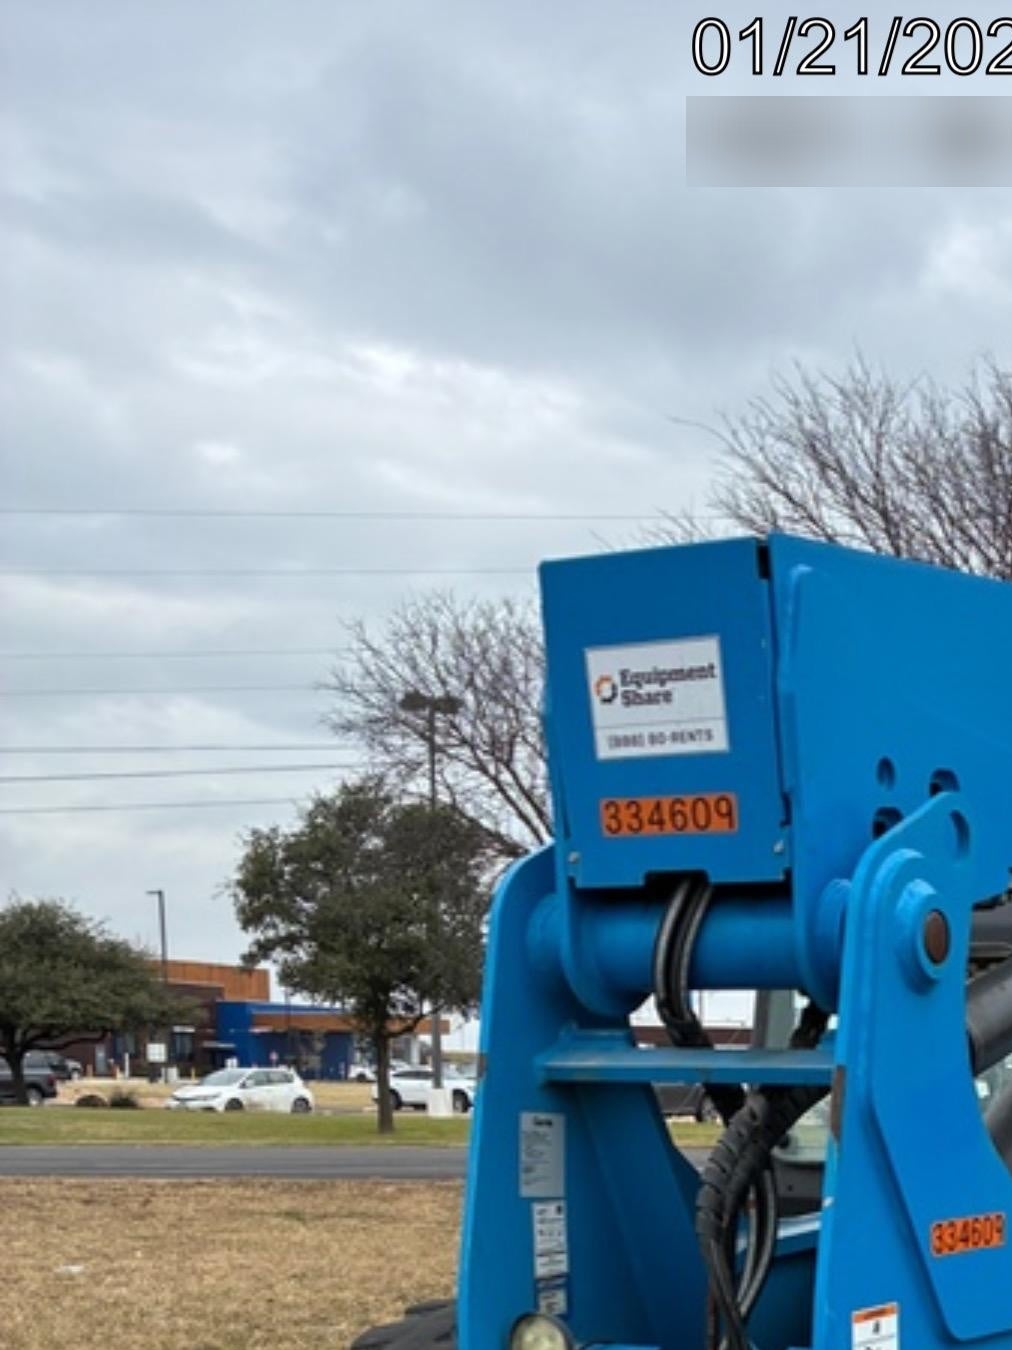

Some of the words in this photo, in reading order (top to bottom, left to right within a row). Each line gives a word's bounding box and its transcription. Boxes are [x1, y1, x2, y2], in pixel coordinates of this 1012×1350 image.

[619, 663, 717, 689] Equipment
[621, 690, 672, 707] Share
[604, 795, 735, 834] 334609
[932, 1215, 1003, 1255] 334609
